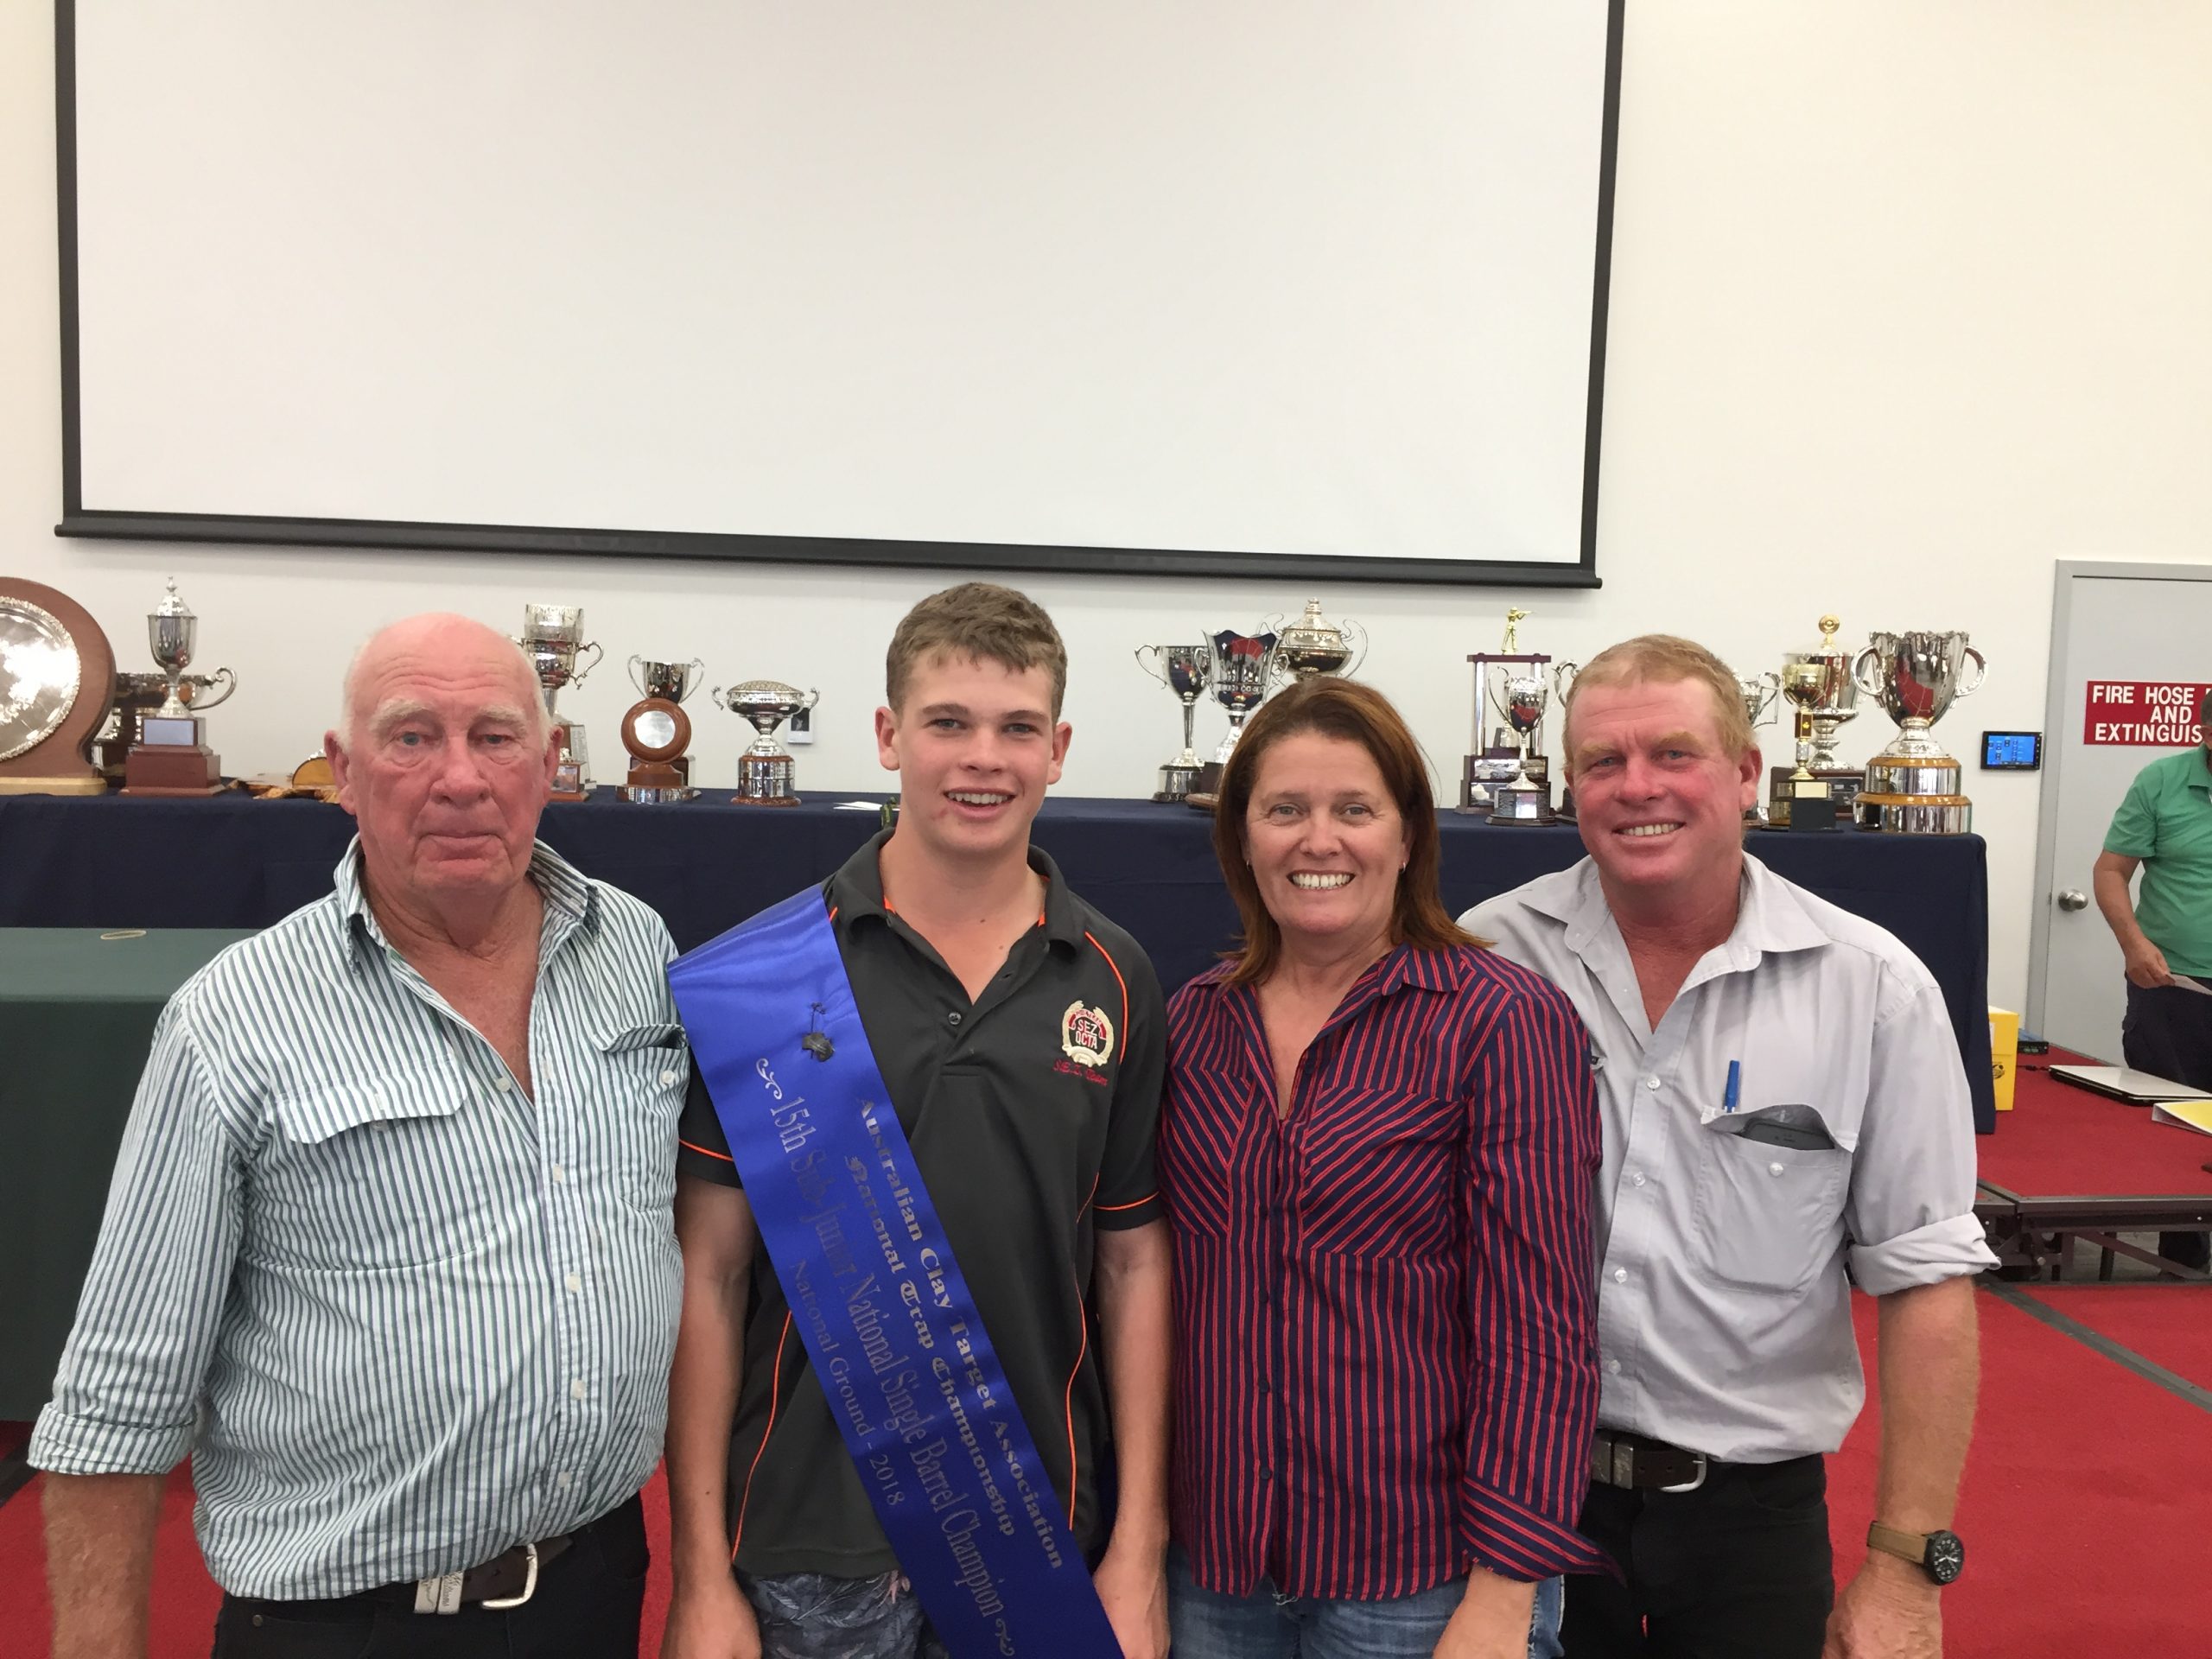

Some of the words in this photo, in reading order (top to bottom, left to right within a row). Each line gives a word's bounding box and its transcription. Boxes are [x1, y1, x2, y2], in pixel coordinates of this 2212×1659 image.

[2093, 685, 2134, 704] FIRE
[2145, 686, 2195, 705] HOSE
[2150, 705, 2192, 724] AND
[2094, 723, 2203, 743] EXTINGUIS
[1077, 1019, 1097, 1037] SEZ
[1076, 1031, 1097, 1050] QCTA
[855, 1097, 923, 1242] Australian
[920, 1248, 954, 1308] Clay
[950, 1316, 997, 1410] Target
[989, 1420, 1063, 1568] Association
[843, 1155, 906, 1274] National
[900, 1279, 935, 1349] Trap
[932, 1357, 1014, 1535] Championship
[770, 1096, 817, 1154] 15th
[838, 1273, 910, 1376] National
[880, 1370, 936, 1444] Single
[910, 1436, 969, 1513] Barrel
[941, 1509, 1006, 1618] Champion
[789, 1259, 840, 1352] National
[829, 1357, 876, 1438] Ground
[868, 1454, 906, 1506] 2018
